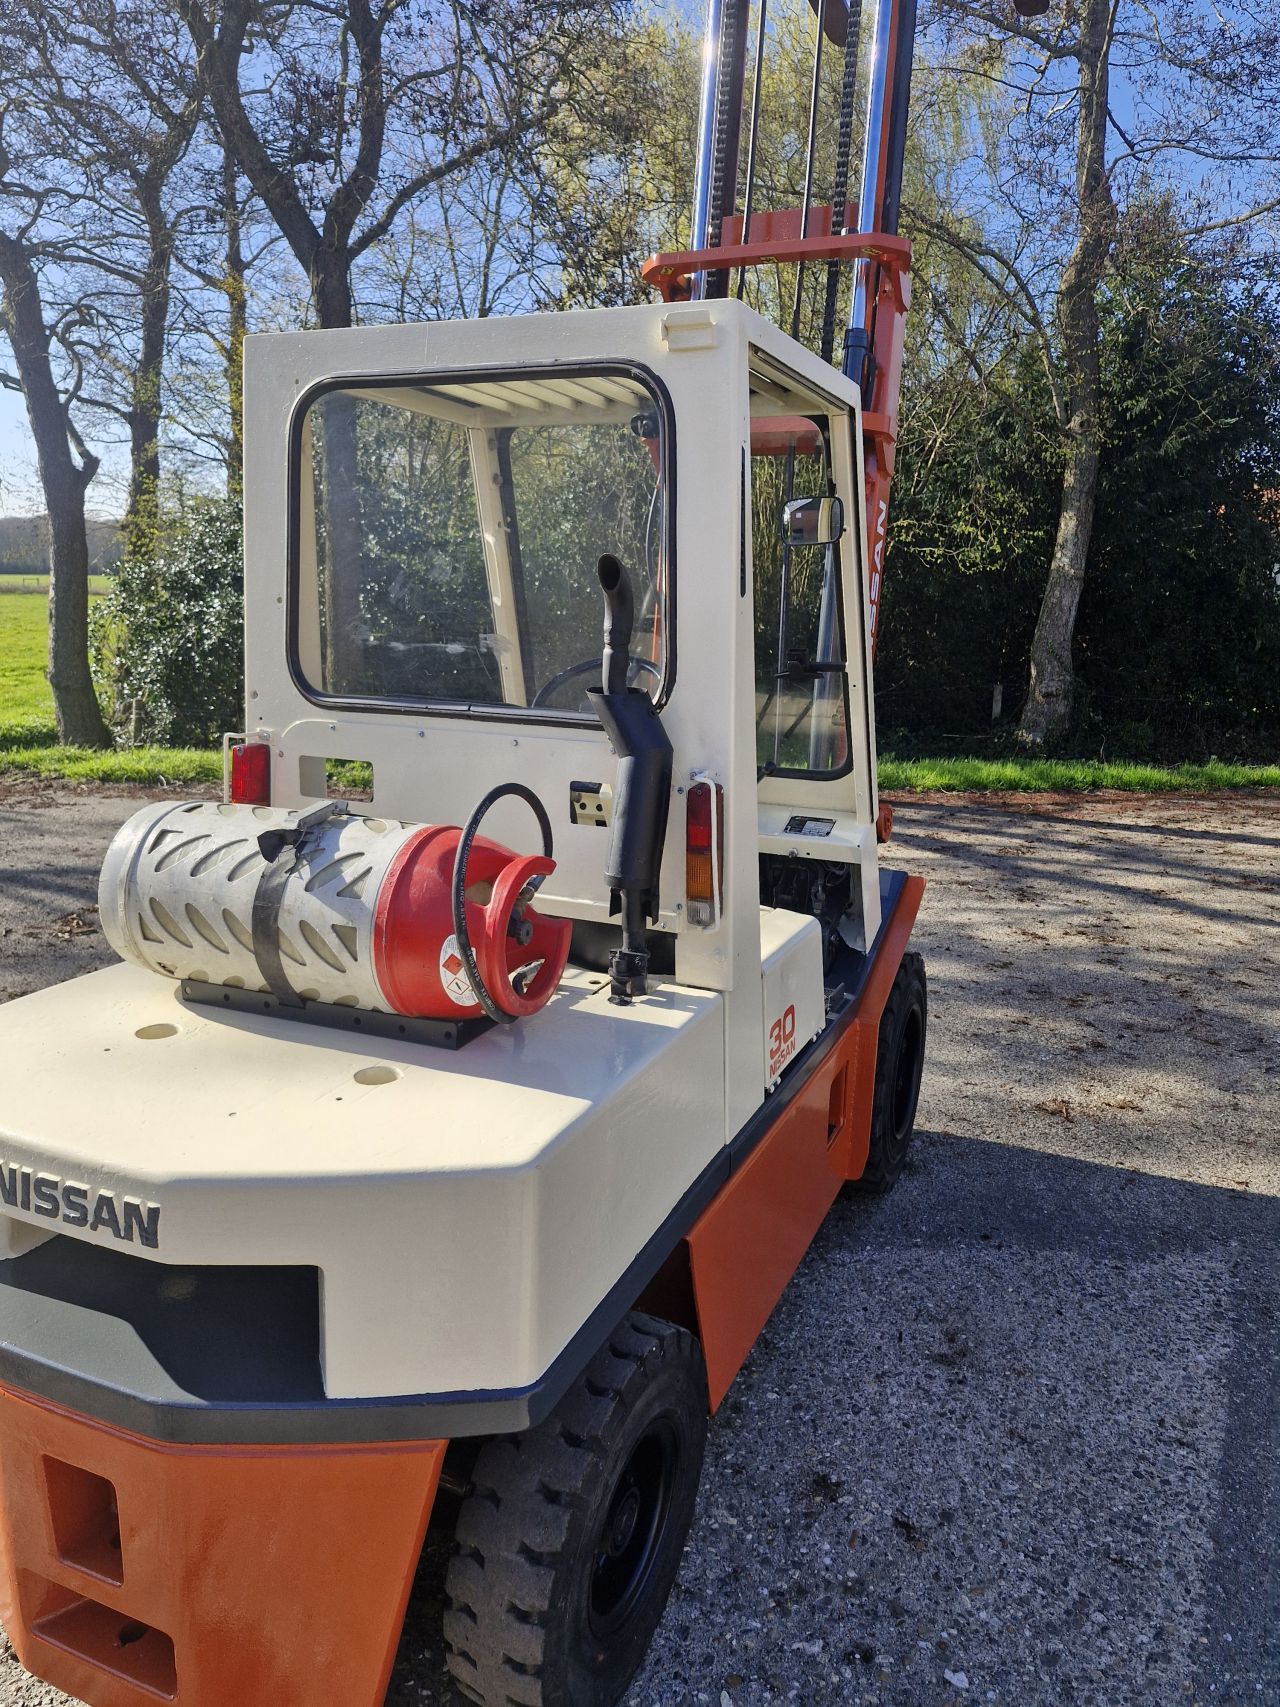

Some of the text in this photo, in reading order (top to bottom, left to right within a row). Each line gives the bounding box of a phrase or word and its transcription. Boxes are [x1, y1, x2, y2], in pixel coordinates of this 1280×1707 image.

[869, 500, 887, 634] SSAN
[769, 1003, 796, 1060] 30
[769, 1037, 796, 1079] NISSAN
